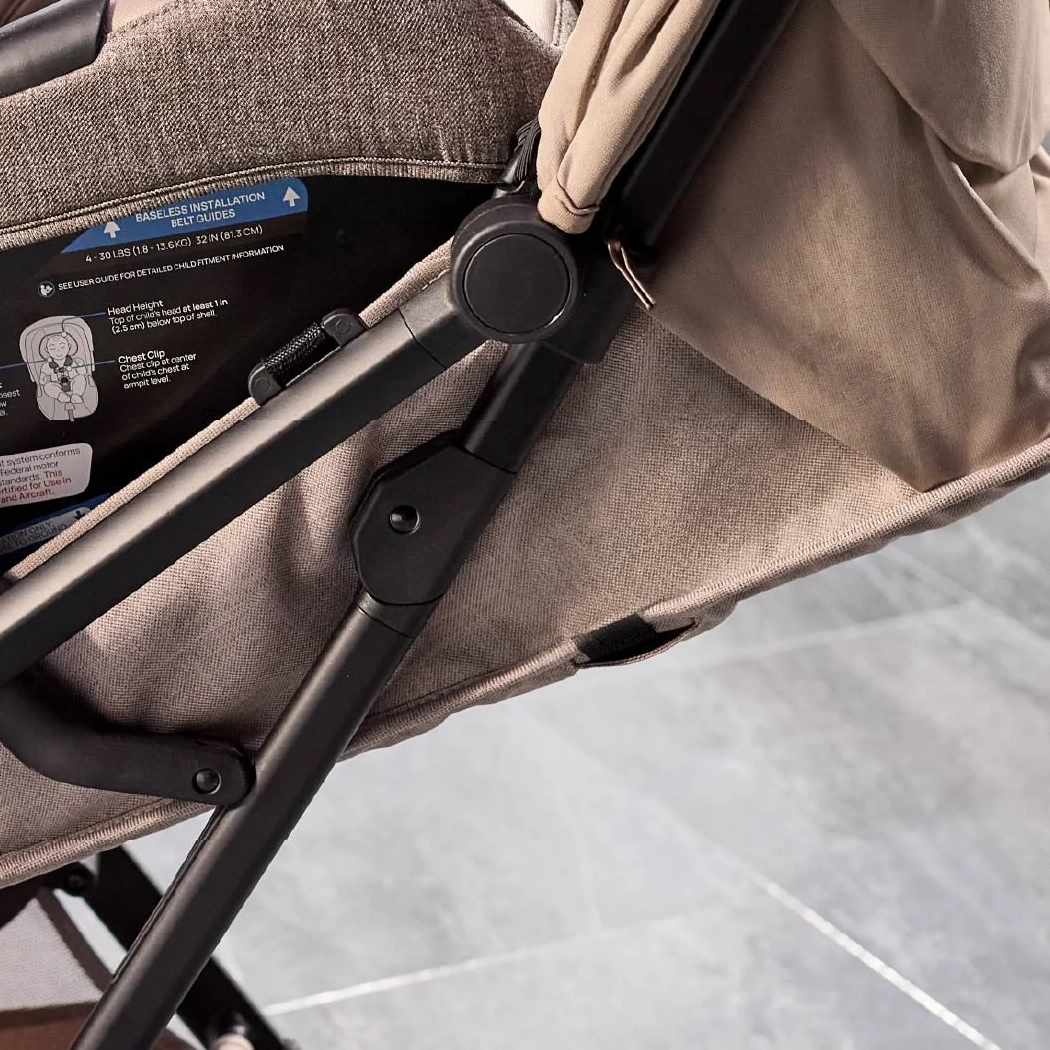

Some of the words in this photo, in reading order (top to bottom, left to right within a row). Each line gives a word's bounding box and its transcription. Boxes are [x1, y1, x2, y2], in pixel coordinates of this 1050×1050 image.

[135, 204, 188, 223] BASELESS
[189, 191, 265, 213] INSTALLATION
[171, 217, 194, 228] BELT
[196, 208, 236, 224] GUIDES
[85, 254, 93, 263] 4
[99, 251, 111, 261] 30
[113, 248, 131, 258] LBS
[132, 245, 149, 257] (1.8
[58, 281, 73, 291] SEE
[73, 278, 95, 288] USER
[95, 273, 120, 284] GUIDE
[120, 270, 136, 281] FOR
[136, 264, 173, 277] DETAILED
[174, 260, 197, 270] CHILD
[197, 255, 231, 266] FITMENT
[231, 244, 284, 260] INFORMATION
[107, 304, 132, 316] Head
[133, 300, 164, 313] Height
[109, 316, 125, 326] Top
[126, 314, 134, 322] of
[135, 310, 161, 321] child's
[162, 306, 181, 316] head
[182, 304, 191, 313] at
[192, 301, 214, 311] least
[219, 298, 229, 306] in
[111, 325, 129, 335] (2.5
[130, 320, 145, 330] cm)
[147, 317, 171, 328] below
[172, 314, 186, 325] top
[187, 312, 195, 321] of
[118, 352, 146, 364] Chest
[147, 350, 166, 361] Clip
[119, 362, 145, 373] Chest
[146, 360, 161, 369] clip
[162, 356, 170, 364] at
[171, 353, 197, 364] center
[121, 373, 131, 381] of
[157, 365, 180, 375] chest
[180, 362, 190, 370] at
[123, 379, 149, 390] armpit
[150, 374, 172, 385] level.
[6, 455, 38, 469] system
[38, 448, 81, 461] conforms
[0, 466, 32, 478] Federal
[33, 461, 60, 471] motor
[44, 469, 63, 479] This
[29, 482, 42, 491] for
[44, 478, 60, 488] Use
[61, 476, 72, 485] in
[1, 494, 18, 504] and
